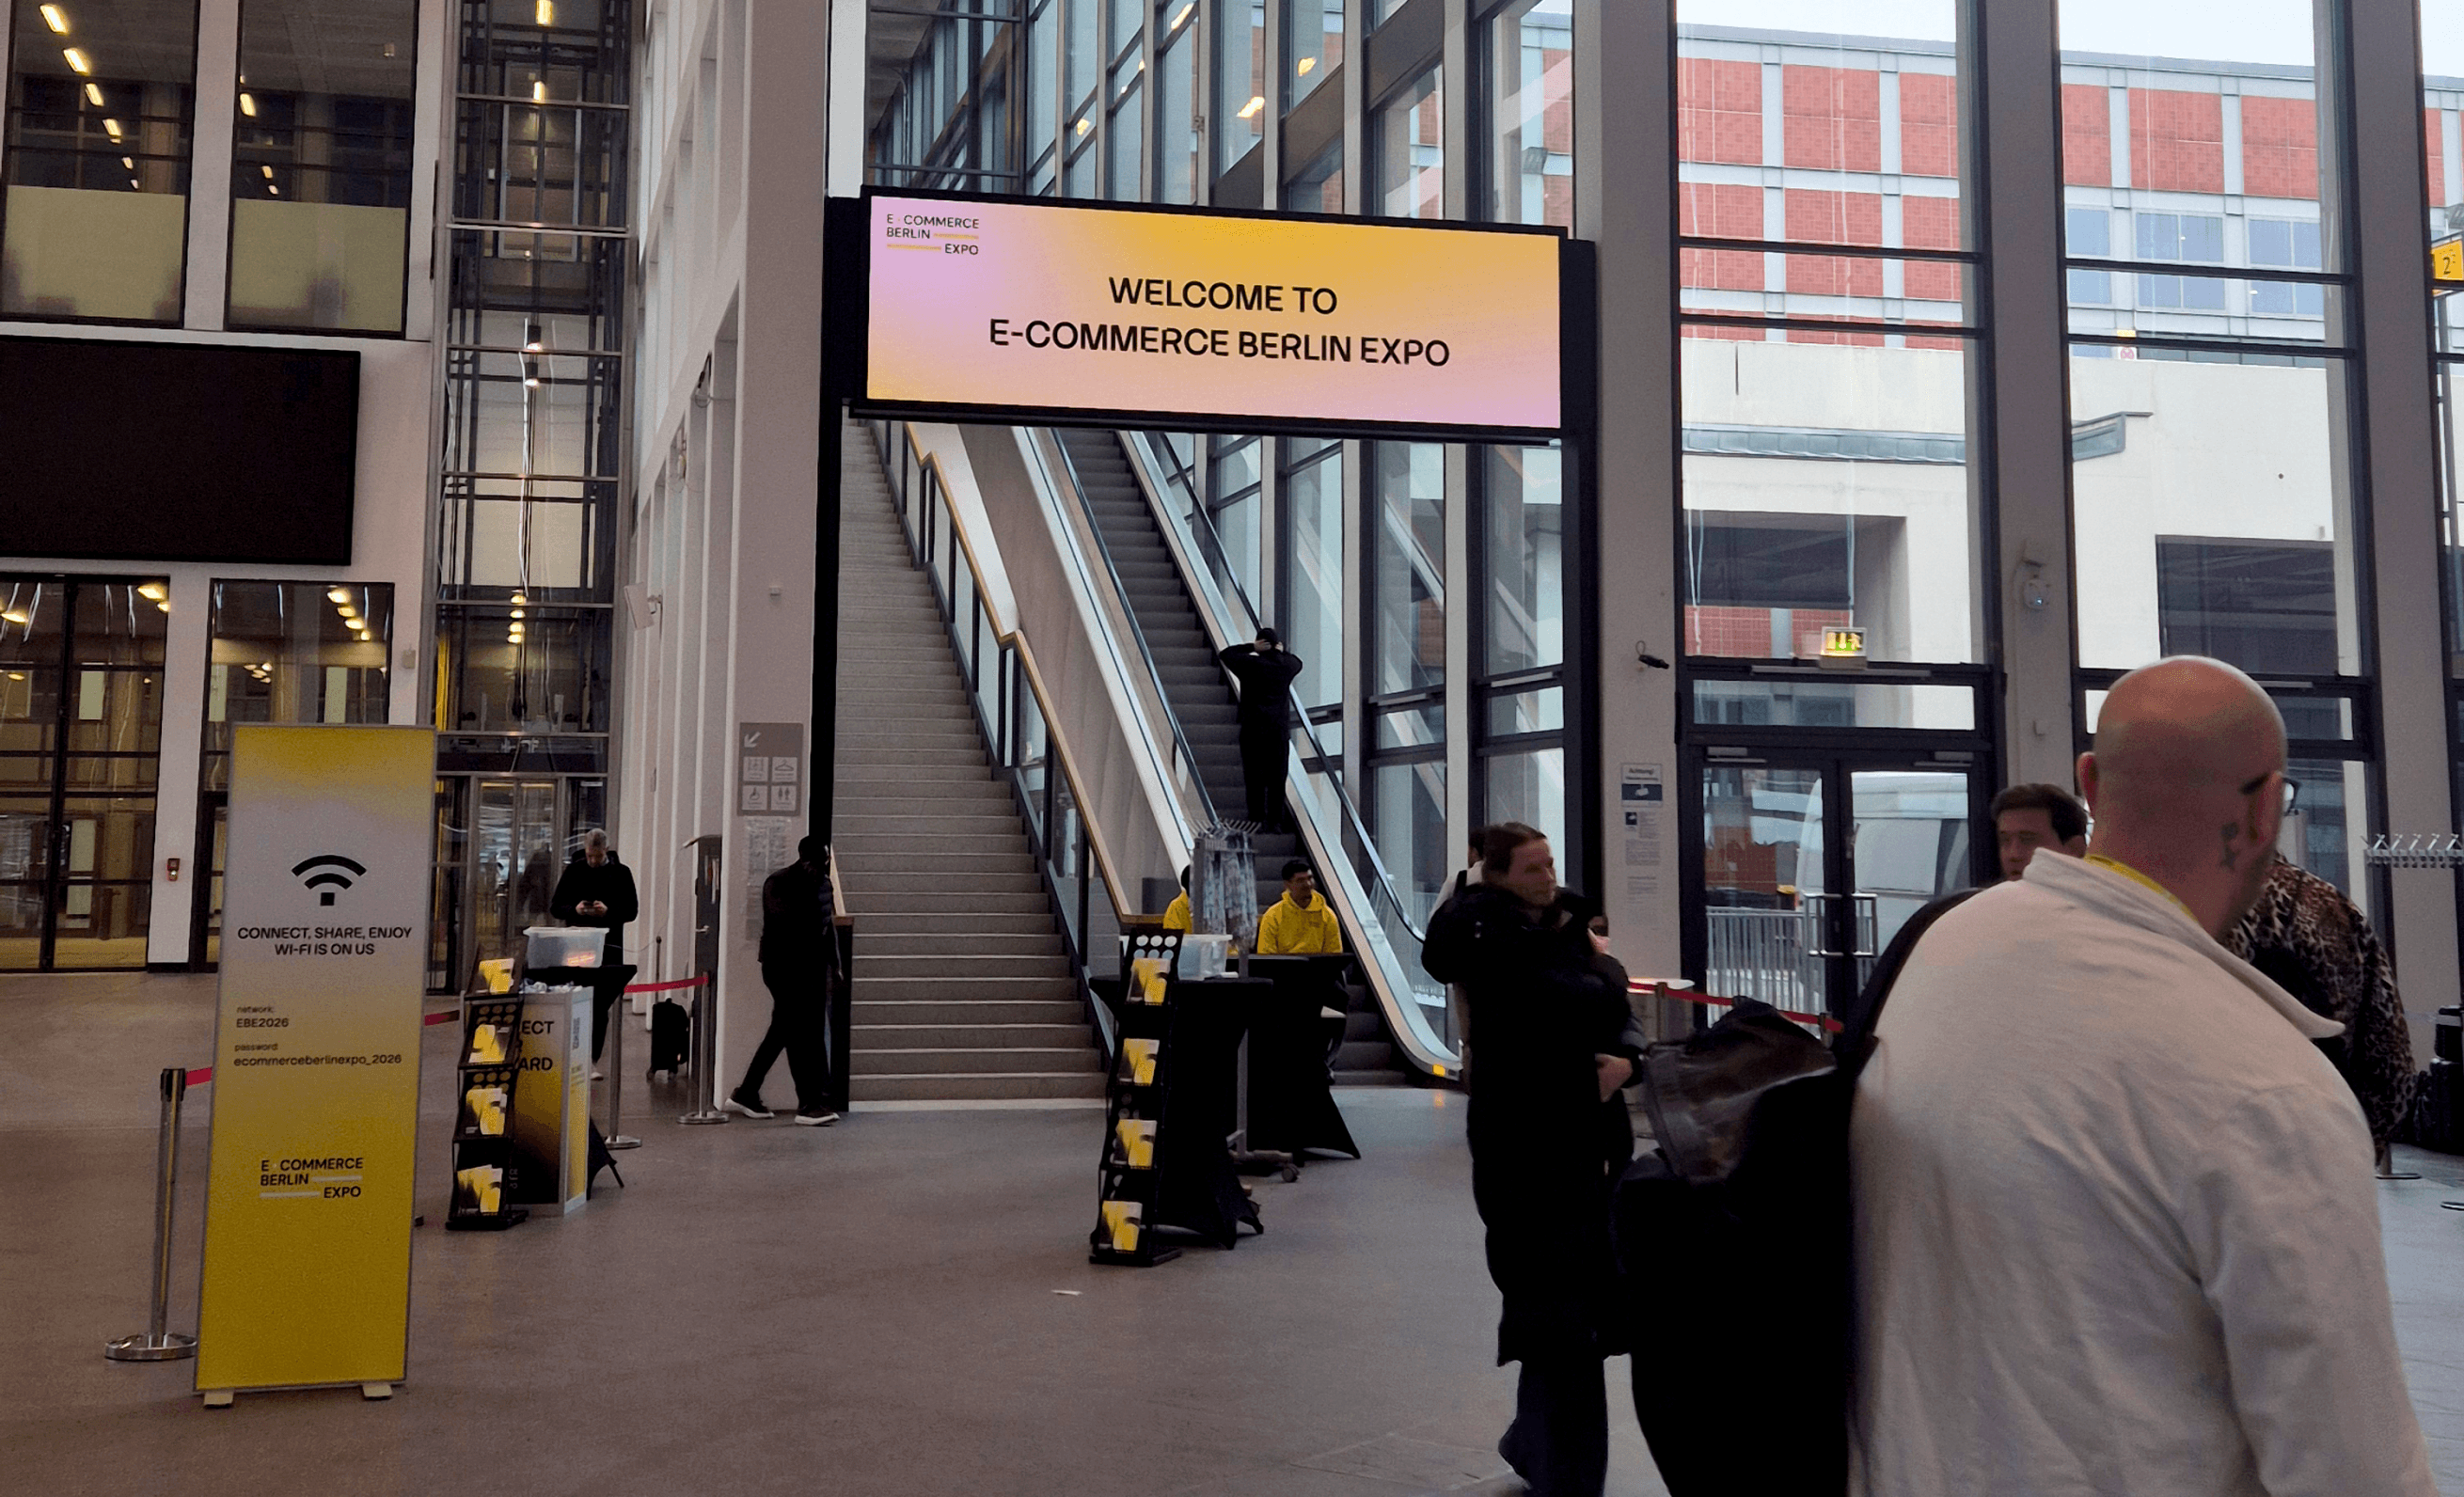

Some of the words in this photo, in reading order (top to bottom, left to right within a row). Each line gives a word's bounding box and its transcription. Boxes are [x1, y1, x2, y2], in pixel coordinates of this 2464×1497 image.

[886, 213, 893, 224] E
[903, 214, 980, 229] COMMERCE
[886, 227, 931, 239] BERLIN
[944, 243, 980, 256] EXPO
[1108, 276, 1284, 312] WELCOME
[1292, 286, 1338, 315] TO
[989, 318, 1229, 357] E-COMMERCE
[1238, 330, 1351, 363] BERLIN
[1360, 337, 1450, 367] EXPO
[237, 926, 312, 940] CONNECT,
[314, 926, 366, 940] SHARE,
[369, 926, 412, 939] ENJOY
[274, 942, 311, 956] WI-FI
[314, 942, 328, 955] IS
[330, 942, 353, 955] ON
[355, 942, 375, 955] US
[236, 1017, 290, 1029] EBE2026
[233, 1053, 403, 1067] ecommerceberlinexpo_2026
[261, 1158, 270, 1172] E
[279, 1157, 364, 1172] COMMERCE
[260, 1173, 309, 1187] BERLIN
[324, 1186, 361, 1199] EXPO
